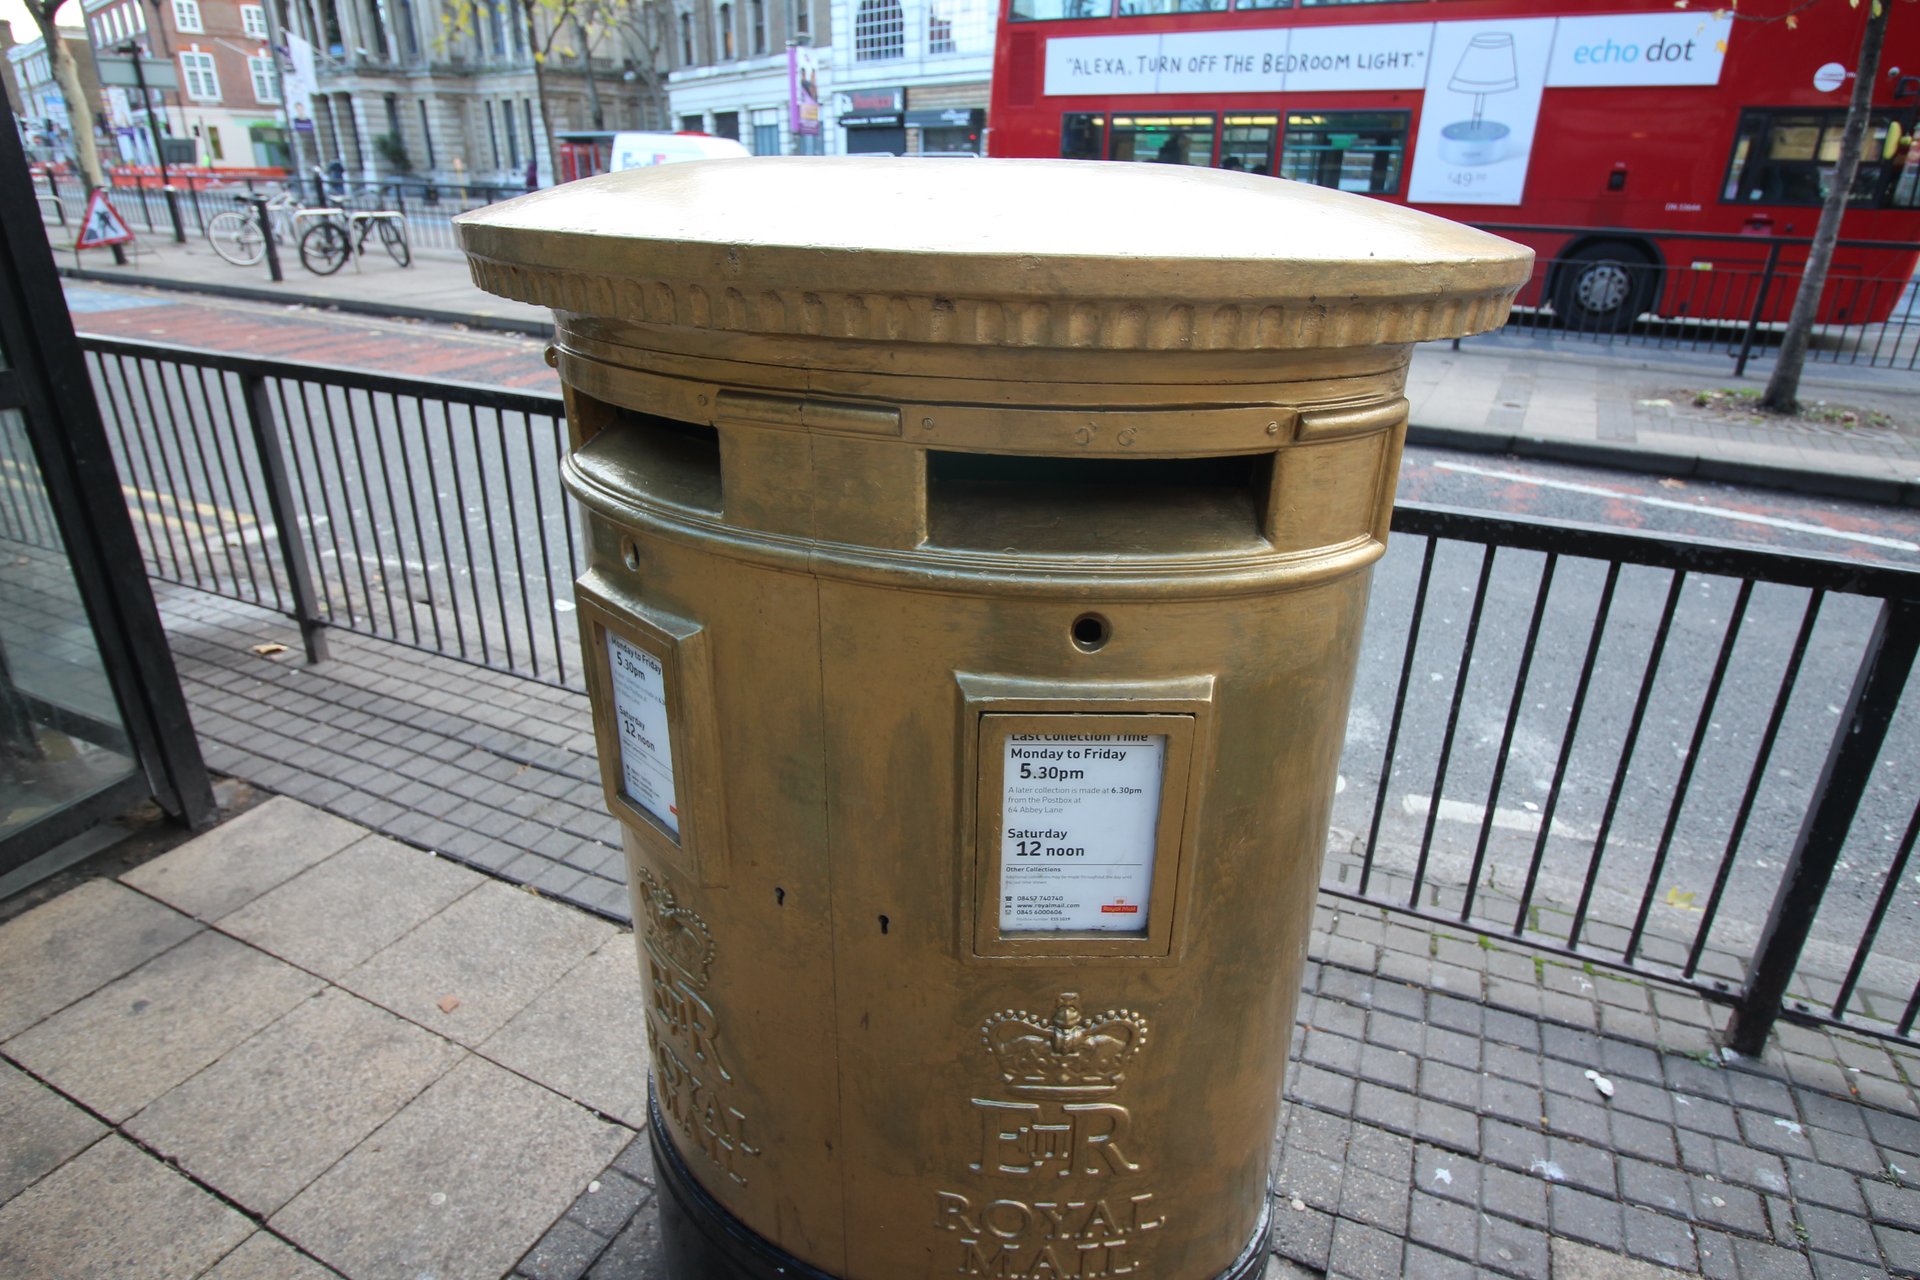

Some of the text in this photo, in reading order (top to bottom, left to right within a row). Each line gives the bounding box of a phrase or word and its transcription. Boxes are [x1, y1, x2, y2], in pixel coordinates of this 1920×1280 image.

[1574, 37, 1695, 64] echo dot
[1137, 55, 1182, 74] TURN
[1188, 55, 1217, 72] OFF
[1224, 54, 1255, 74] THE
[1262, 52, 1350, 74] BEDROOM
[611, 636, 662, 675] Monday to Friday
[616, 651, 646, 680] 5.30pm
[619, 705, 645, 731] Saturday
[624, 720, 636, 738] 12
[637, 733, 656, 752] noon
[1011, 748, 1127, 761] Monday to Friday
[1020, 762, 1084, 782] 5.30pm
[1111, 787, 1142, 795] 6.30pm
[1020, 806, 1043, 815] Abbey
[1008, 828, 1068, 840] Saturday
[1016, 841, 1085, 856] 12 noon
[933, 1190, 1166, 1240] ROYAL
[957, 1239, 1141, 1280] MAIL
